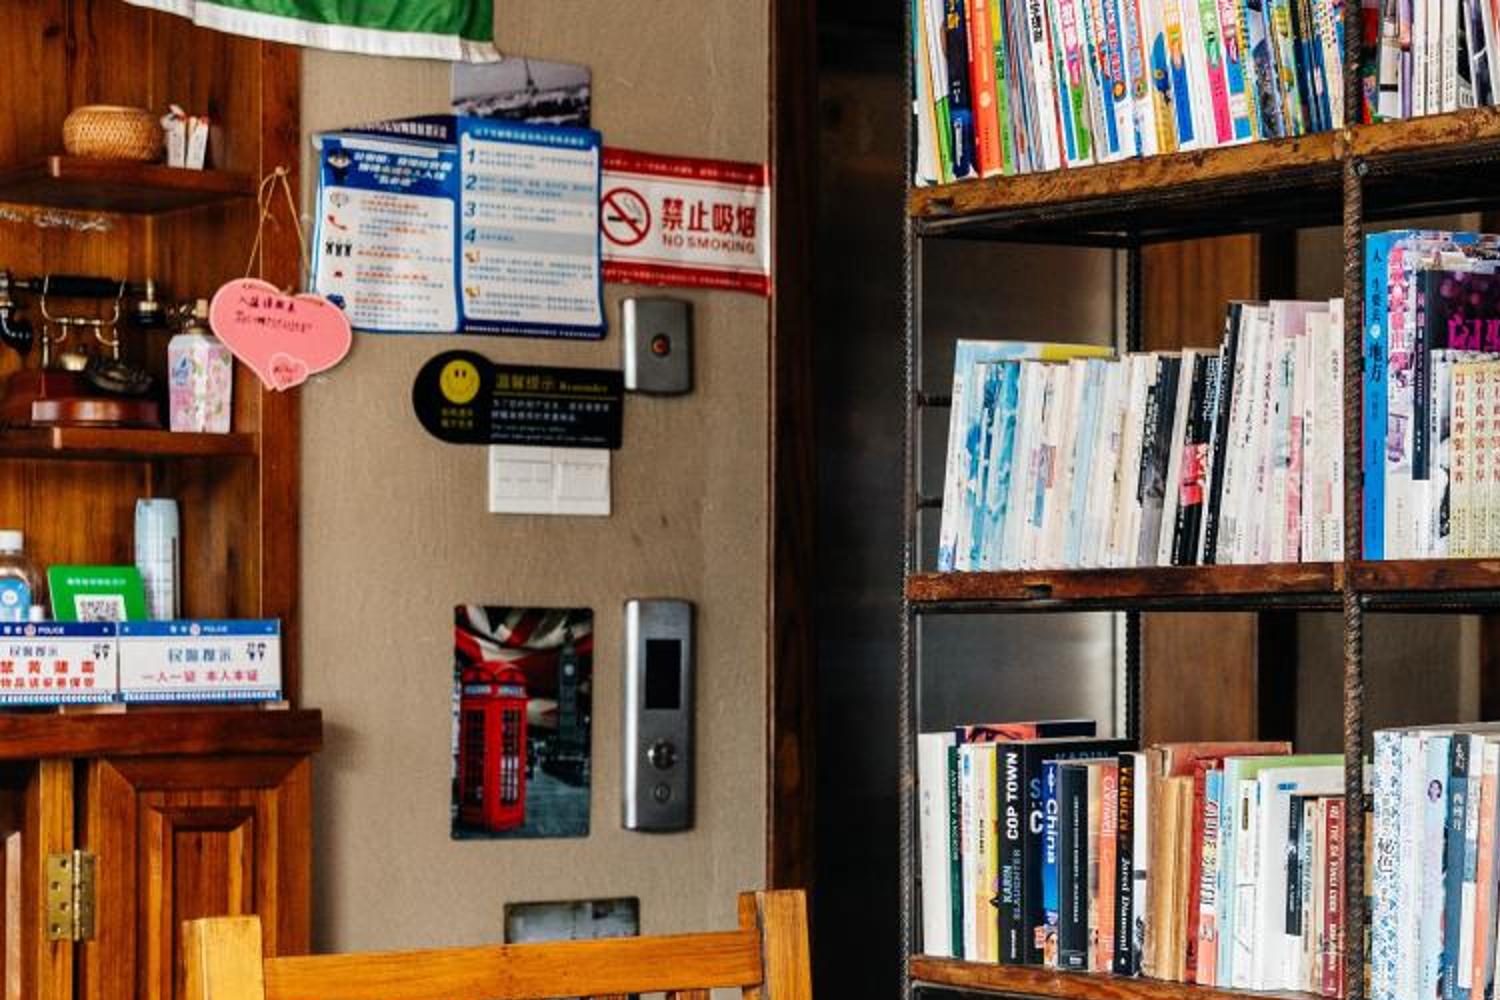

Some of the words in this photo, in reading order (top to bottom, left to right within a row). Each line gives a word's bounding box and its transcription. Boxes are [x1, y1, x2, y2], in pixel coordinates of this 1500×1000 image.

[661, 198, 757, 239] 禁止吸烟
[662, 233, 684, 247] NO
[688, 234, 756, 255] SMOKING
[1005, 752, 1019, 801] TOWN
[1006, 806, 1019, 840] COP
[1046, 798, 1058, 864] China
[1003, 865, 1013, 903] KARIN
[1121, 857, 1132, 892] Jared
[1119, 895, 1130, 952] Diamond
